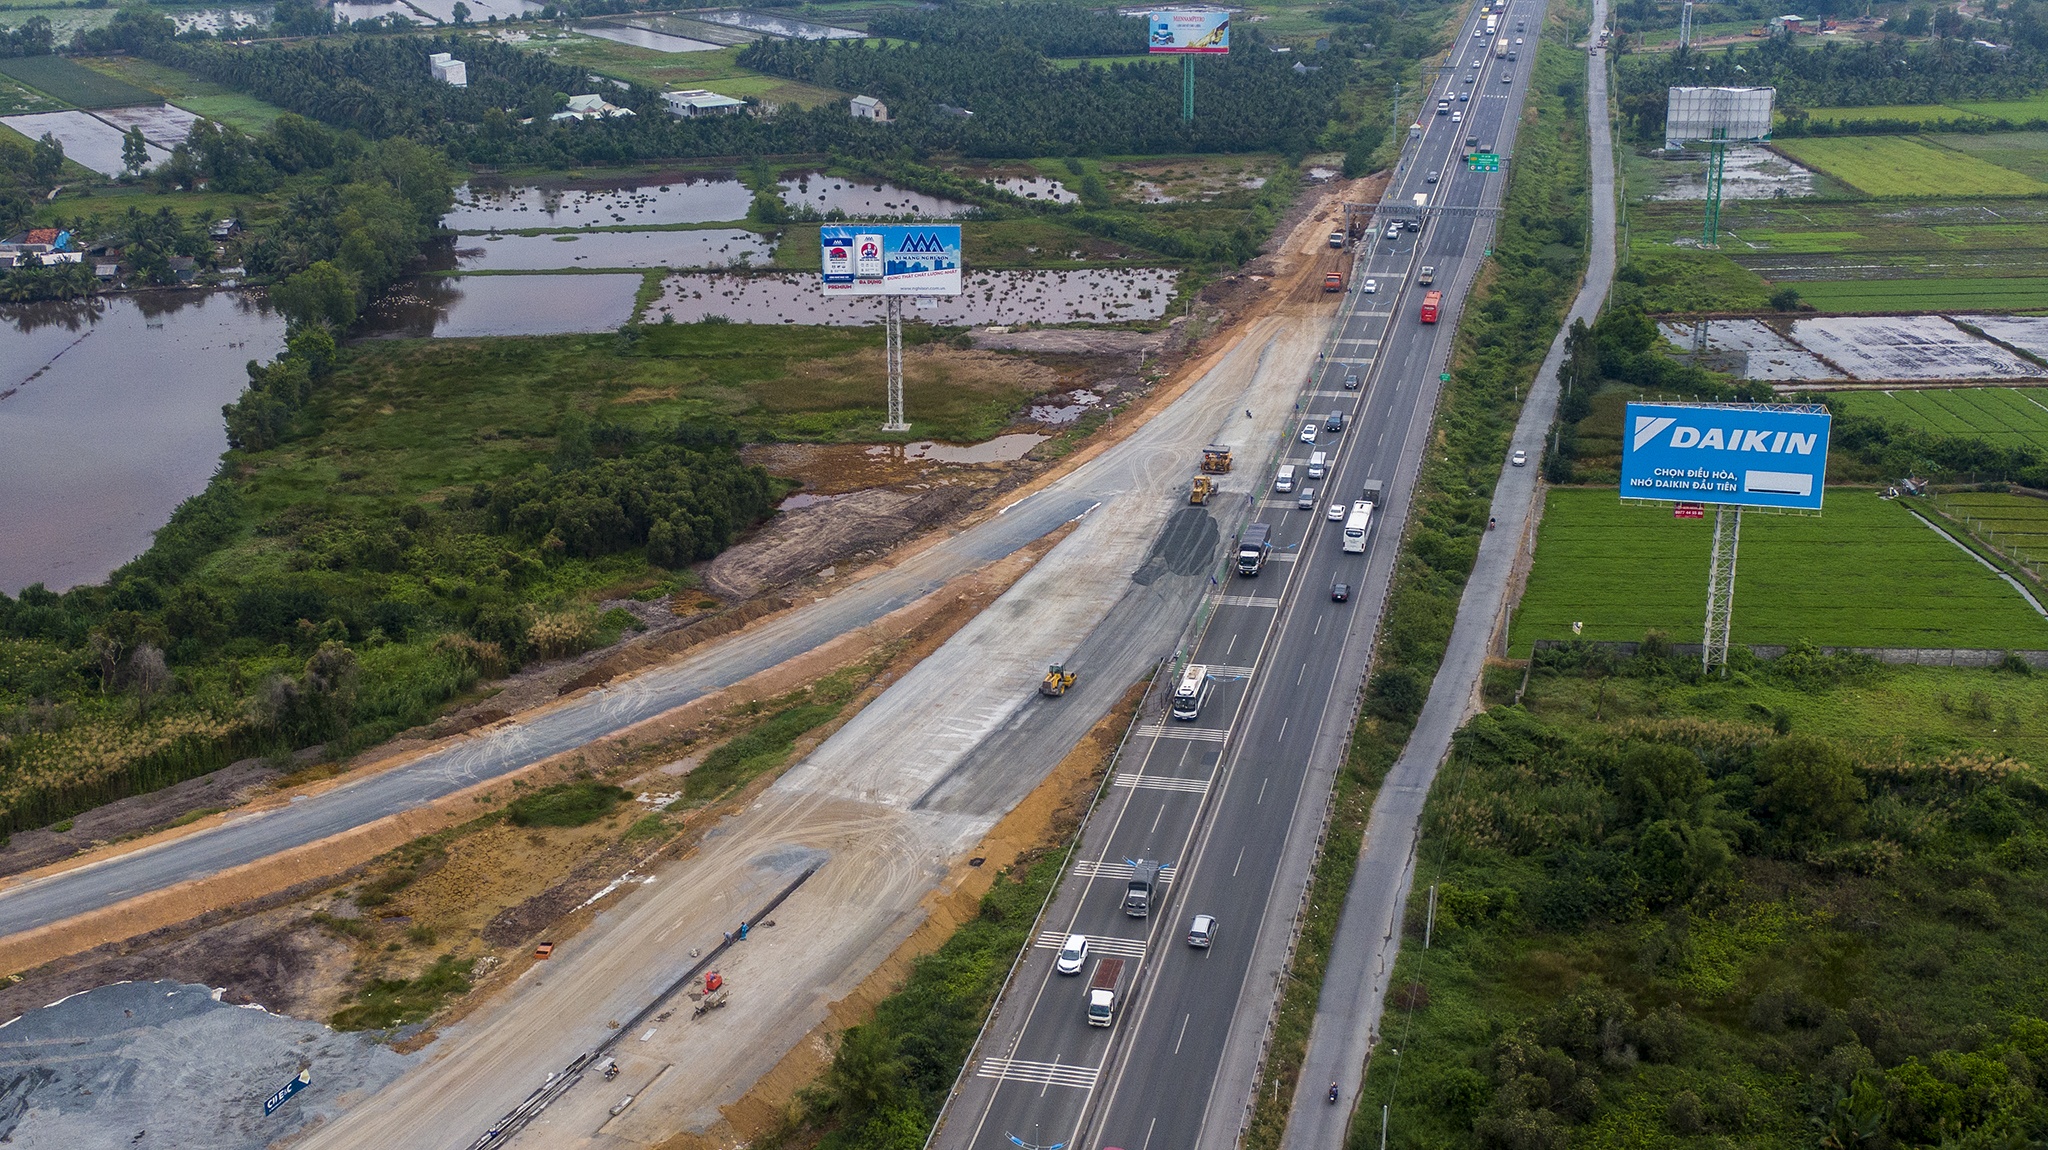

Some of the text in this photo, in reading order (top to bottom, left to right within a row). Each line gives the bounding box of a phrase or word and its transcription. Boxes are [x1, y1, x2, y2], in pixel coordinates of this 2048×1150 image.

[1669, 426, 1818, 455] DAIKIN
[1654, 467, 1738, 481] CHỌN ĐIỀU HÒA,
[1630, 478, 1737, 492] NHỚ DAIKIN ĐẦU TIÊN
